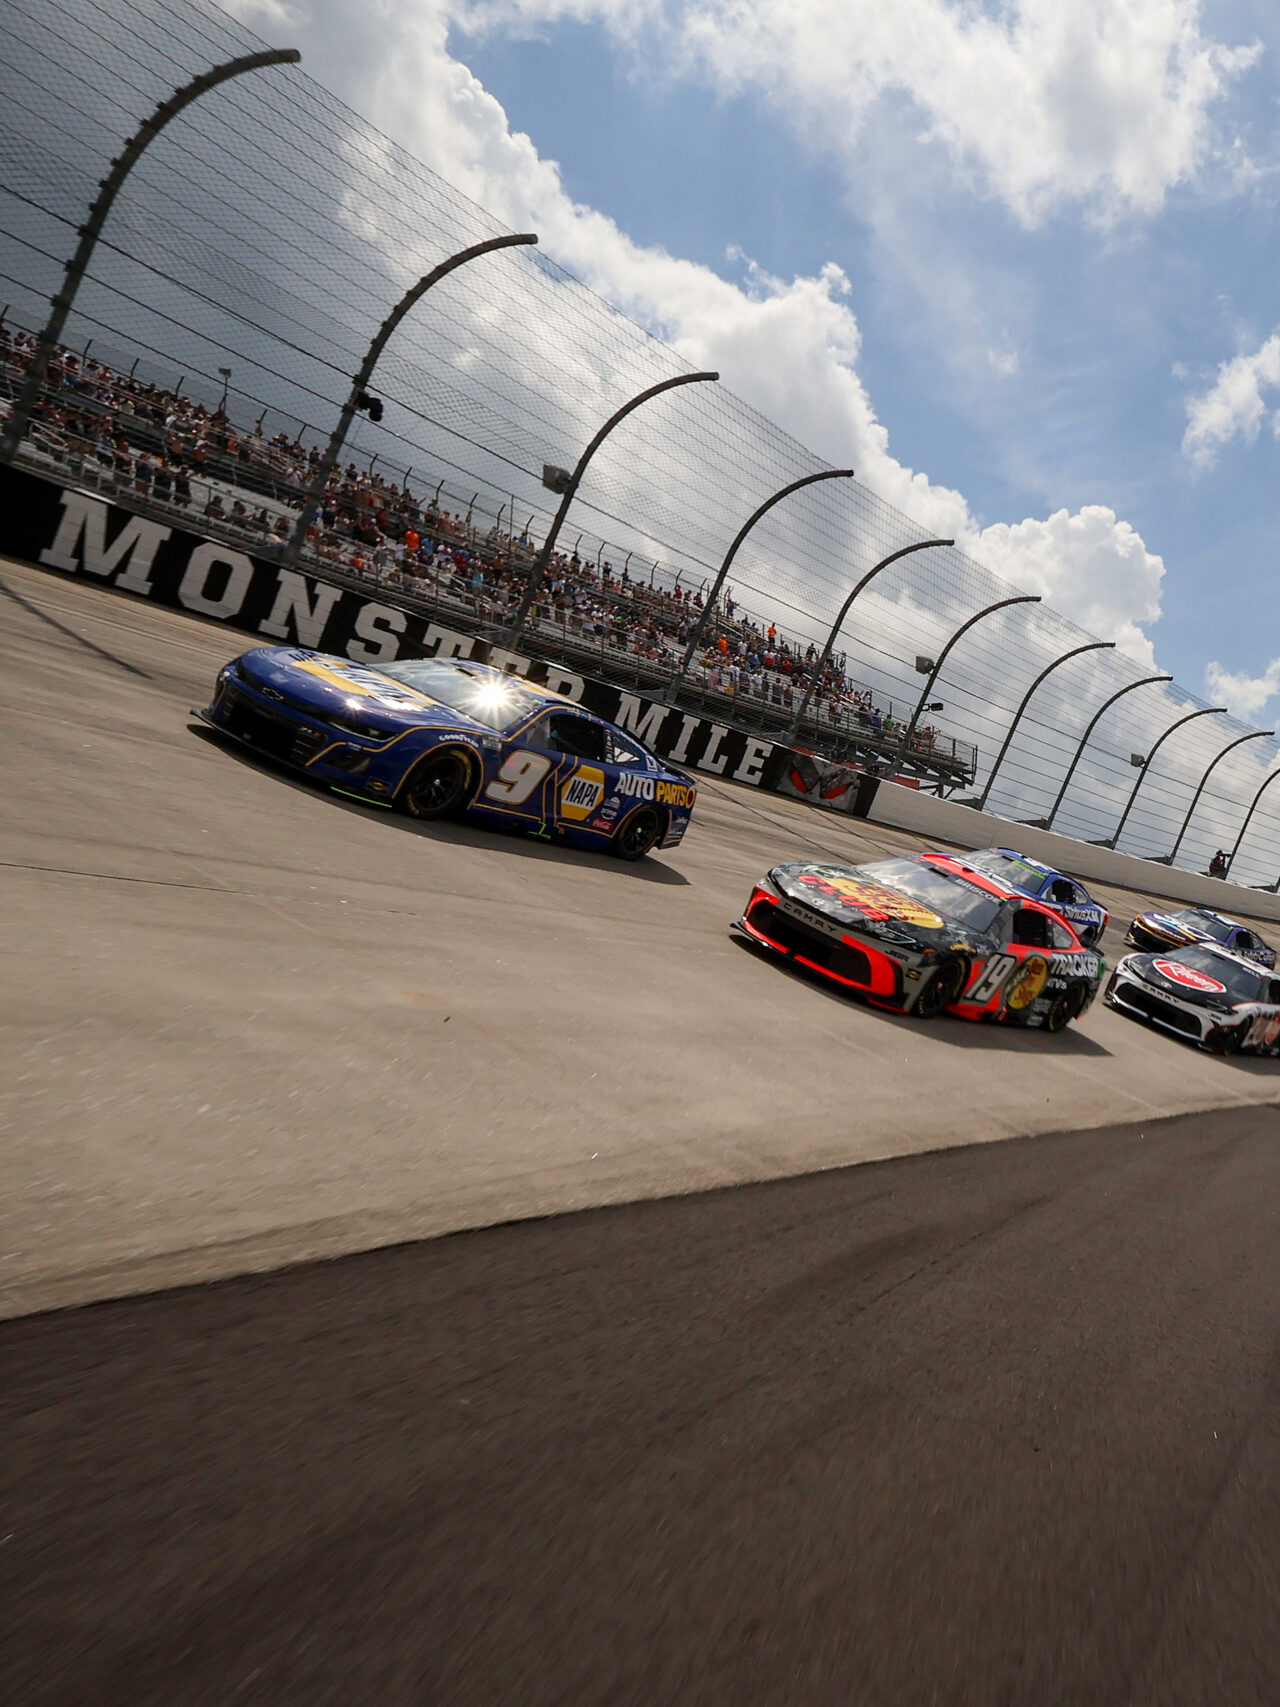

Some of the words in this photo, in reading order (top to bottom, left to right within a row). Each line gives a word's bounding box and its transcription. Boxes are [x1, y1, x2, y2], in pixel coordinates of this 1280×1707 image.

[614, 692, 774, 786] MILE
[486, 750, 552, 806] 9
[565, 779, 600, 808] NAPA
[613, 772, 655, 801] AUTO
[656, 781, 688, 807] PARTS
[798, 874, 891, 921] CLUB
[955, 878, 1001, 904] BRISCOE
[783, 902, 838, 933] CAMRY
[964, 953, 1017, 1001] 19
[1051, 953, 1099, 978] TRACKER
[1157, 962, 1220, 992] Rheem
[1142, 984, 1179, 1004] CAMRY
